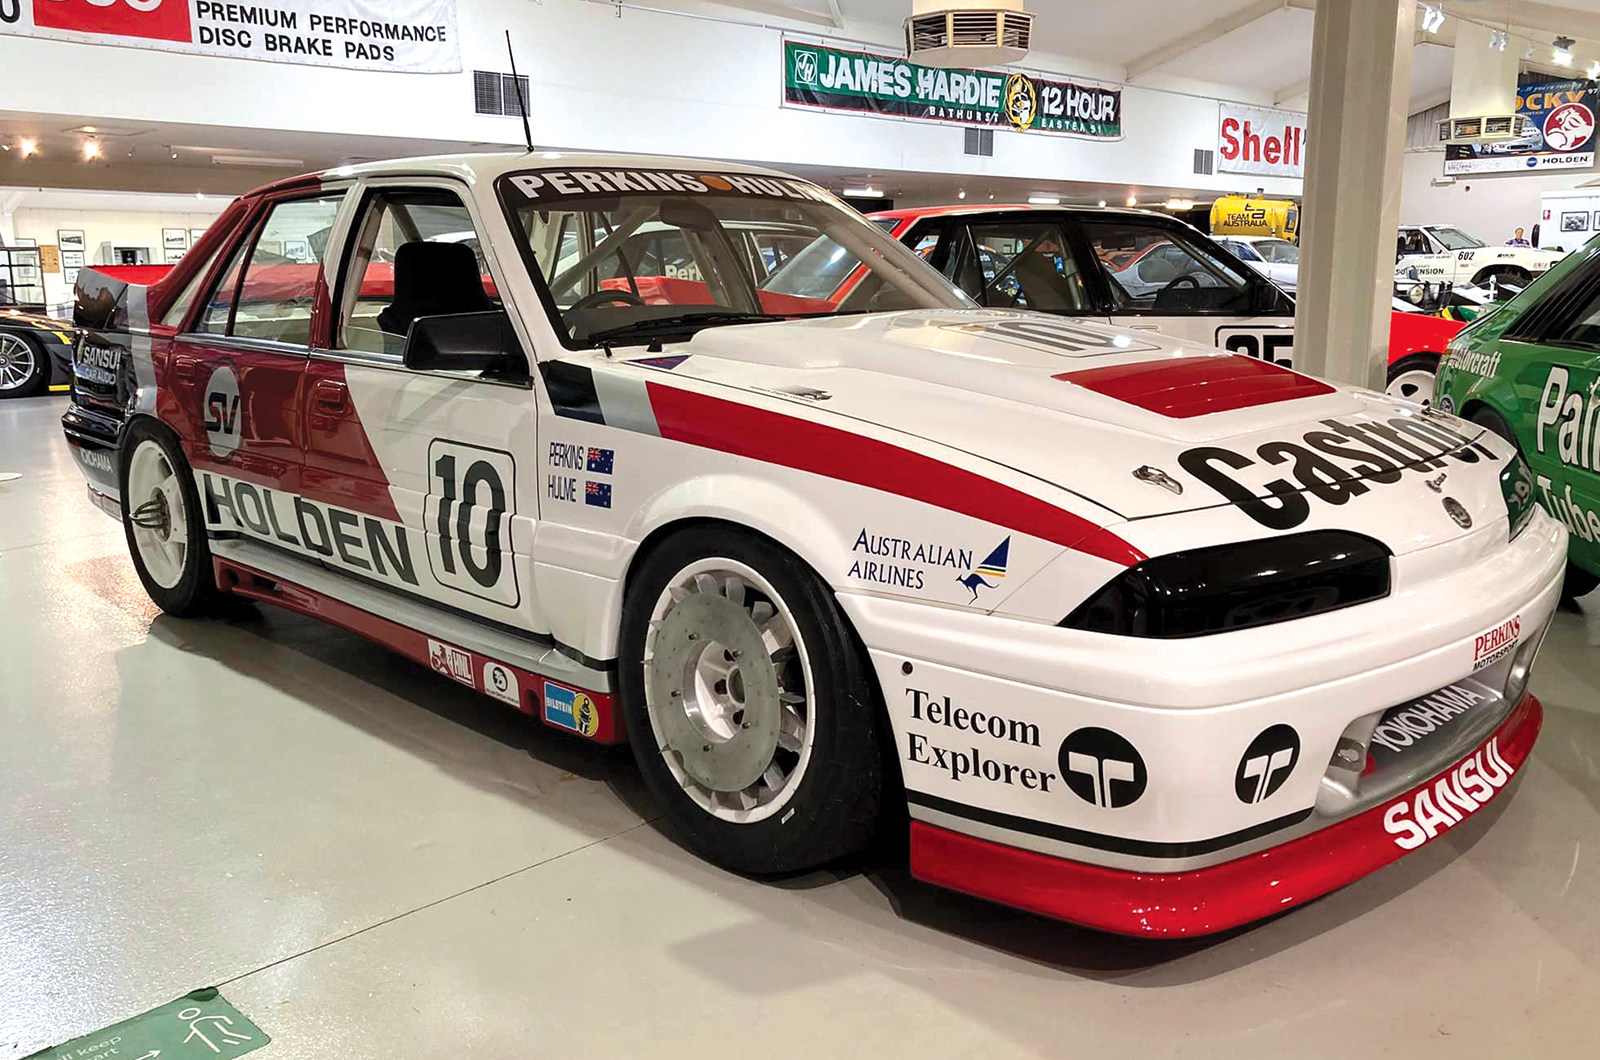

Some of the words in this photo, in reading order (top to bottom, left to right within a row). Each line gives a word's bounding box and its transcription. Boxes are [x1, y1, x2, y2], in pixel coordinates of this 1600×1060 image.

[197, 1, 297, 29] PREMIUM
[309, 14, 446, 42] PERFORMANCE
[200, 26, 251, 48] DISC
[265, 33, 333, 56] BRAKE
[345, 42, 394, 61] PADS
[819, 54, 911, 98] JAMES
[916, 68, 1002, 108] HARDIE
[929, 106, 999, 123] BATHURST
[1042, 87, 1063, 115] 12
[1066, 89, 1115, 121] HOUR
[1220, 117, 1300, 166] Shell
[1542, 156, 1588, 164] HOLDEN
[509, 171, 708, 198] PERKINS
[1458, 251, 1475, 260] 602
[84, 346, 120, 370] SANSUI
[1452, 343, 1502, 378] Motorcraft
[549, 442, 584, 470] PERKINS
[547, 474, 577, 503] HULME
[1178, 418, 1499, 530] Castrol
[203, 474, 419, 586] HOLDEN
[435, 454, 506, 588] 10
[852, 527, 973, 570] AUSTRALIAN
[847, 560, 924, 589] AIRLINES
[1473, 639, 1518, 671] MOTORSPORT
[1474, 615, 1520, 660] PERKINS
[905, 688, 1041, 747] Telecom
[1372, 685, 1485, 752] YOKOHAMA
[906, 732, 1056, 793] Explorer
[1383, 736, 1515, 850] SANSUI
[77, 1036, 121, 1056] keep
